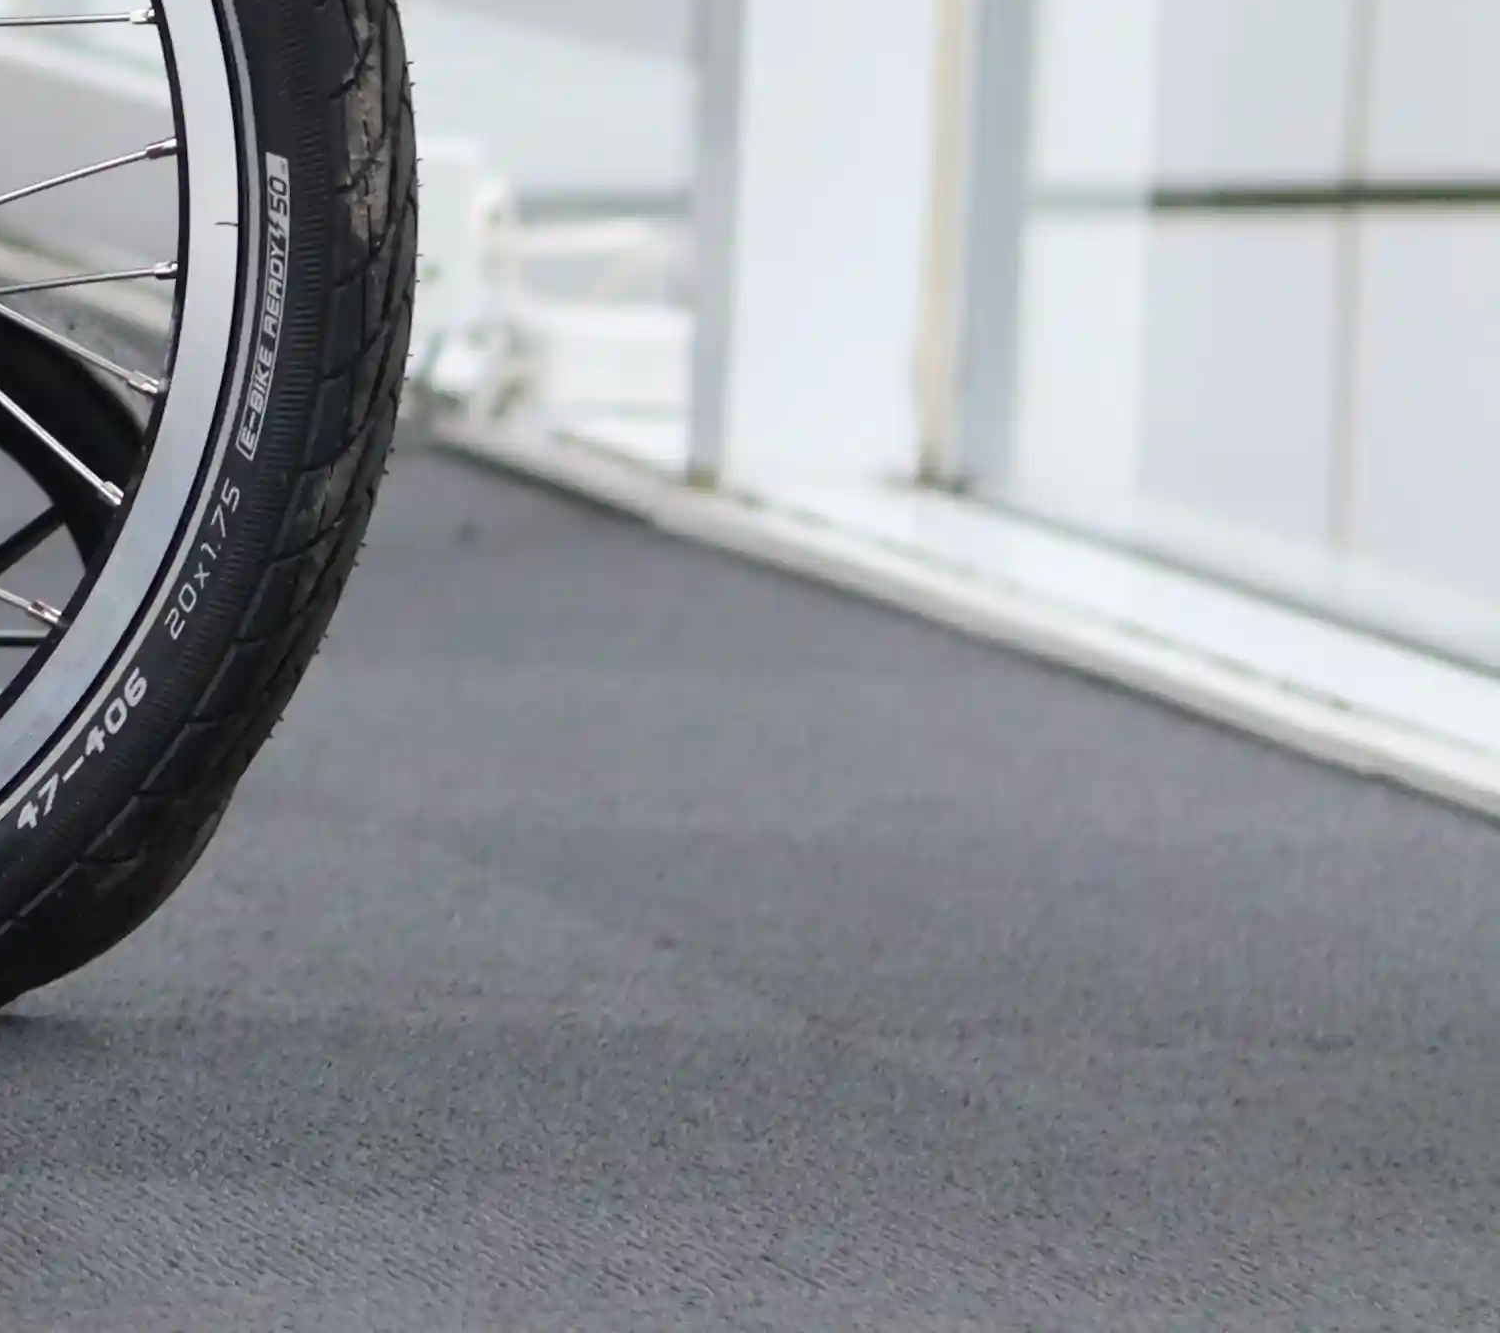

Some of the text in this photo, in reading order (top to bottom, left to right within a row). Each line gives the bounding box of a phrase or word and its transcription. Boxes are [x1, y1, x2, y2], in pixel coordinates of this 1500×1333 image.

[241, 175, 290, 450] E-BIKE READY 50
[165, 480, 242, 640] 20x1.75
[15, 666, 148, 830] 47-406
